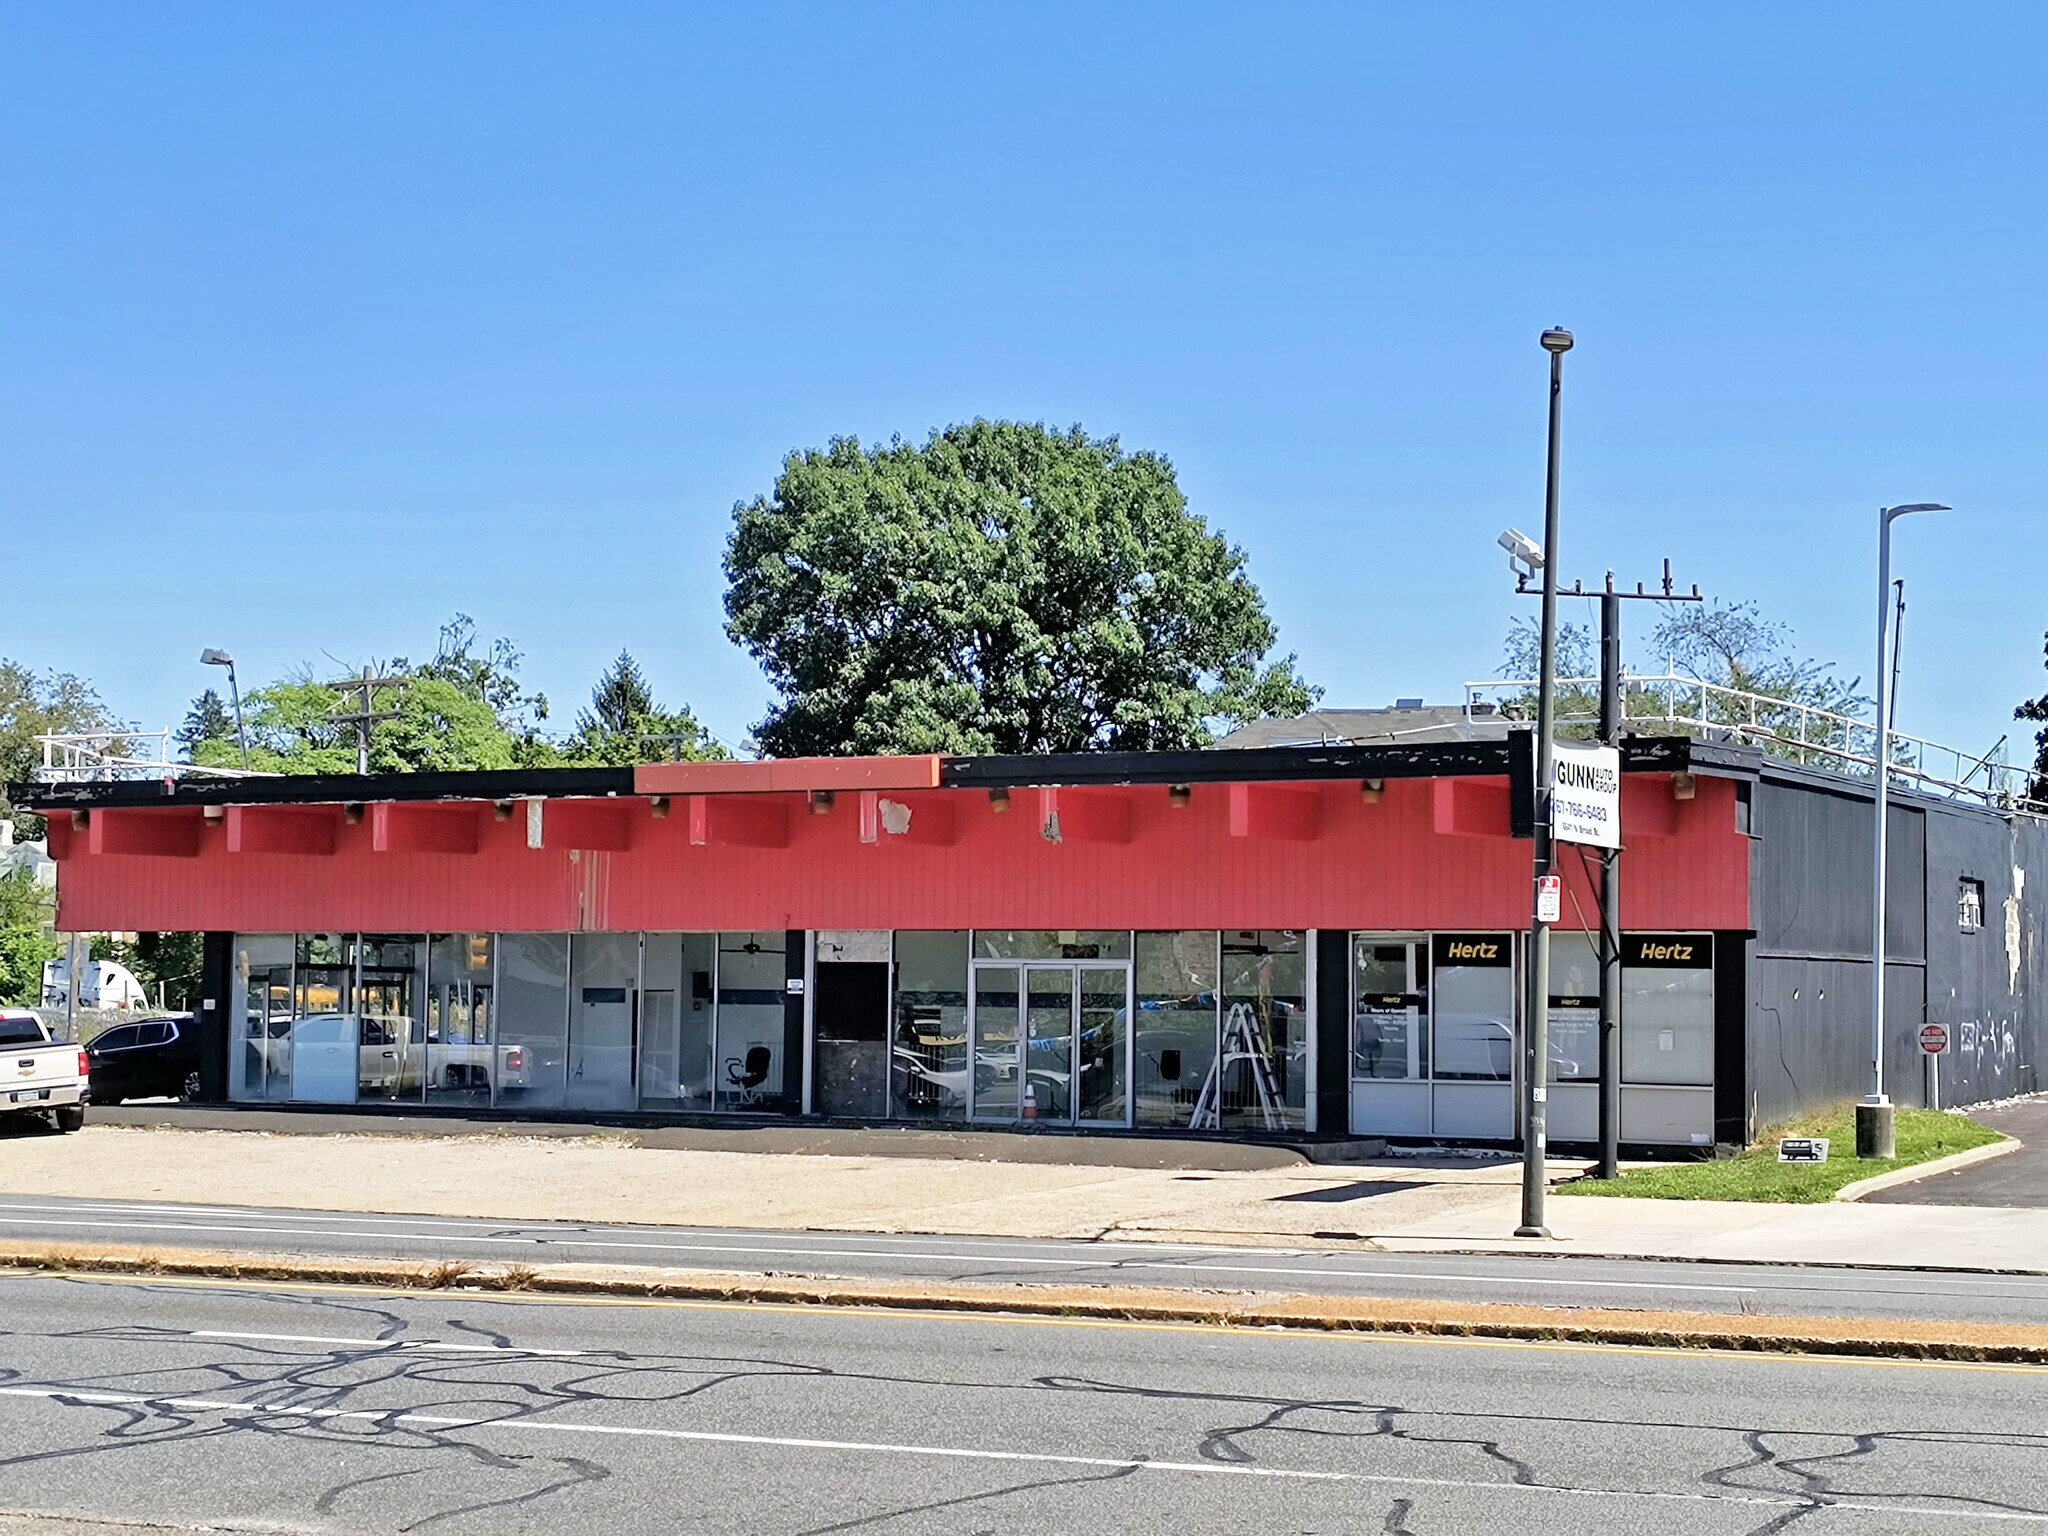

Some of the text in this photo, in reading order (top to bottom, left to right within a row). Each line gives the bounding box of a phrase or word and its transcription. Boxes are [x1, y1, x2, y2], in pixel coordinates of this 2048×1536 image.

[1557, 761, 1595, 790] GUNN
[1596, 768, 1613, 781] AUTO
[1595, 780, 1617, 794] GROUP
[1449, 942, 1498, 958] Hertz
[1641, 943, 1693, 959] Hertz
